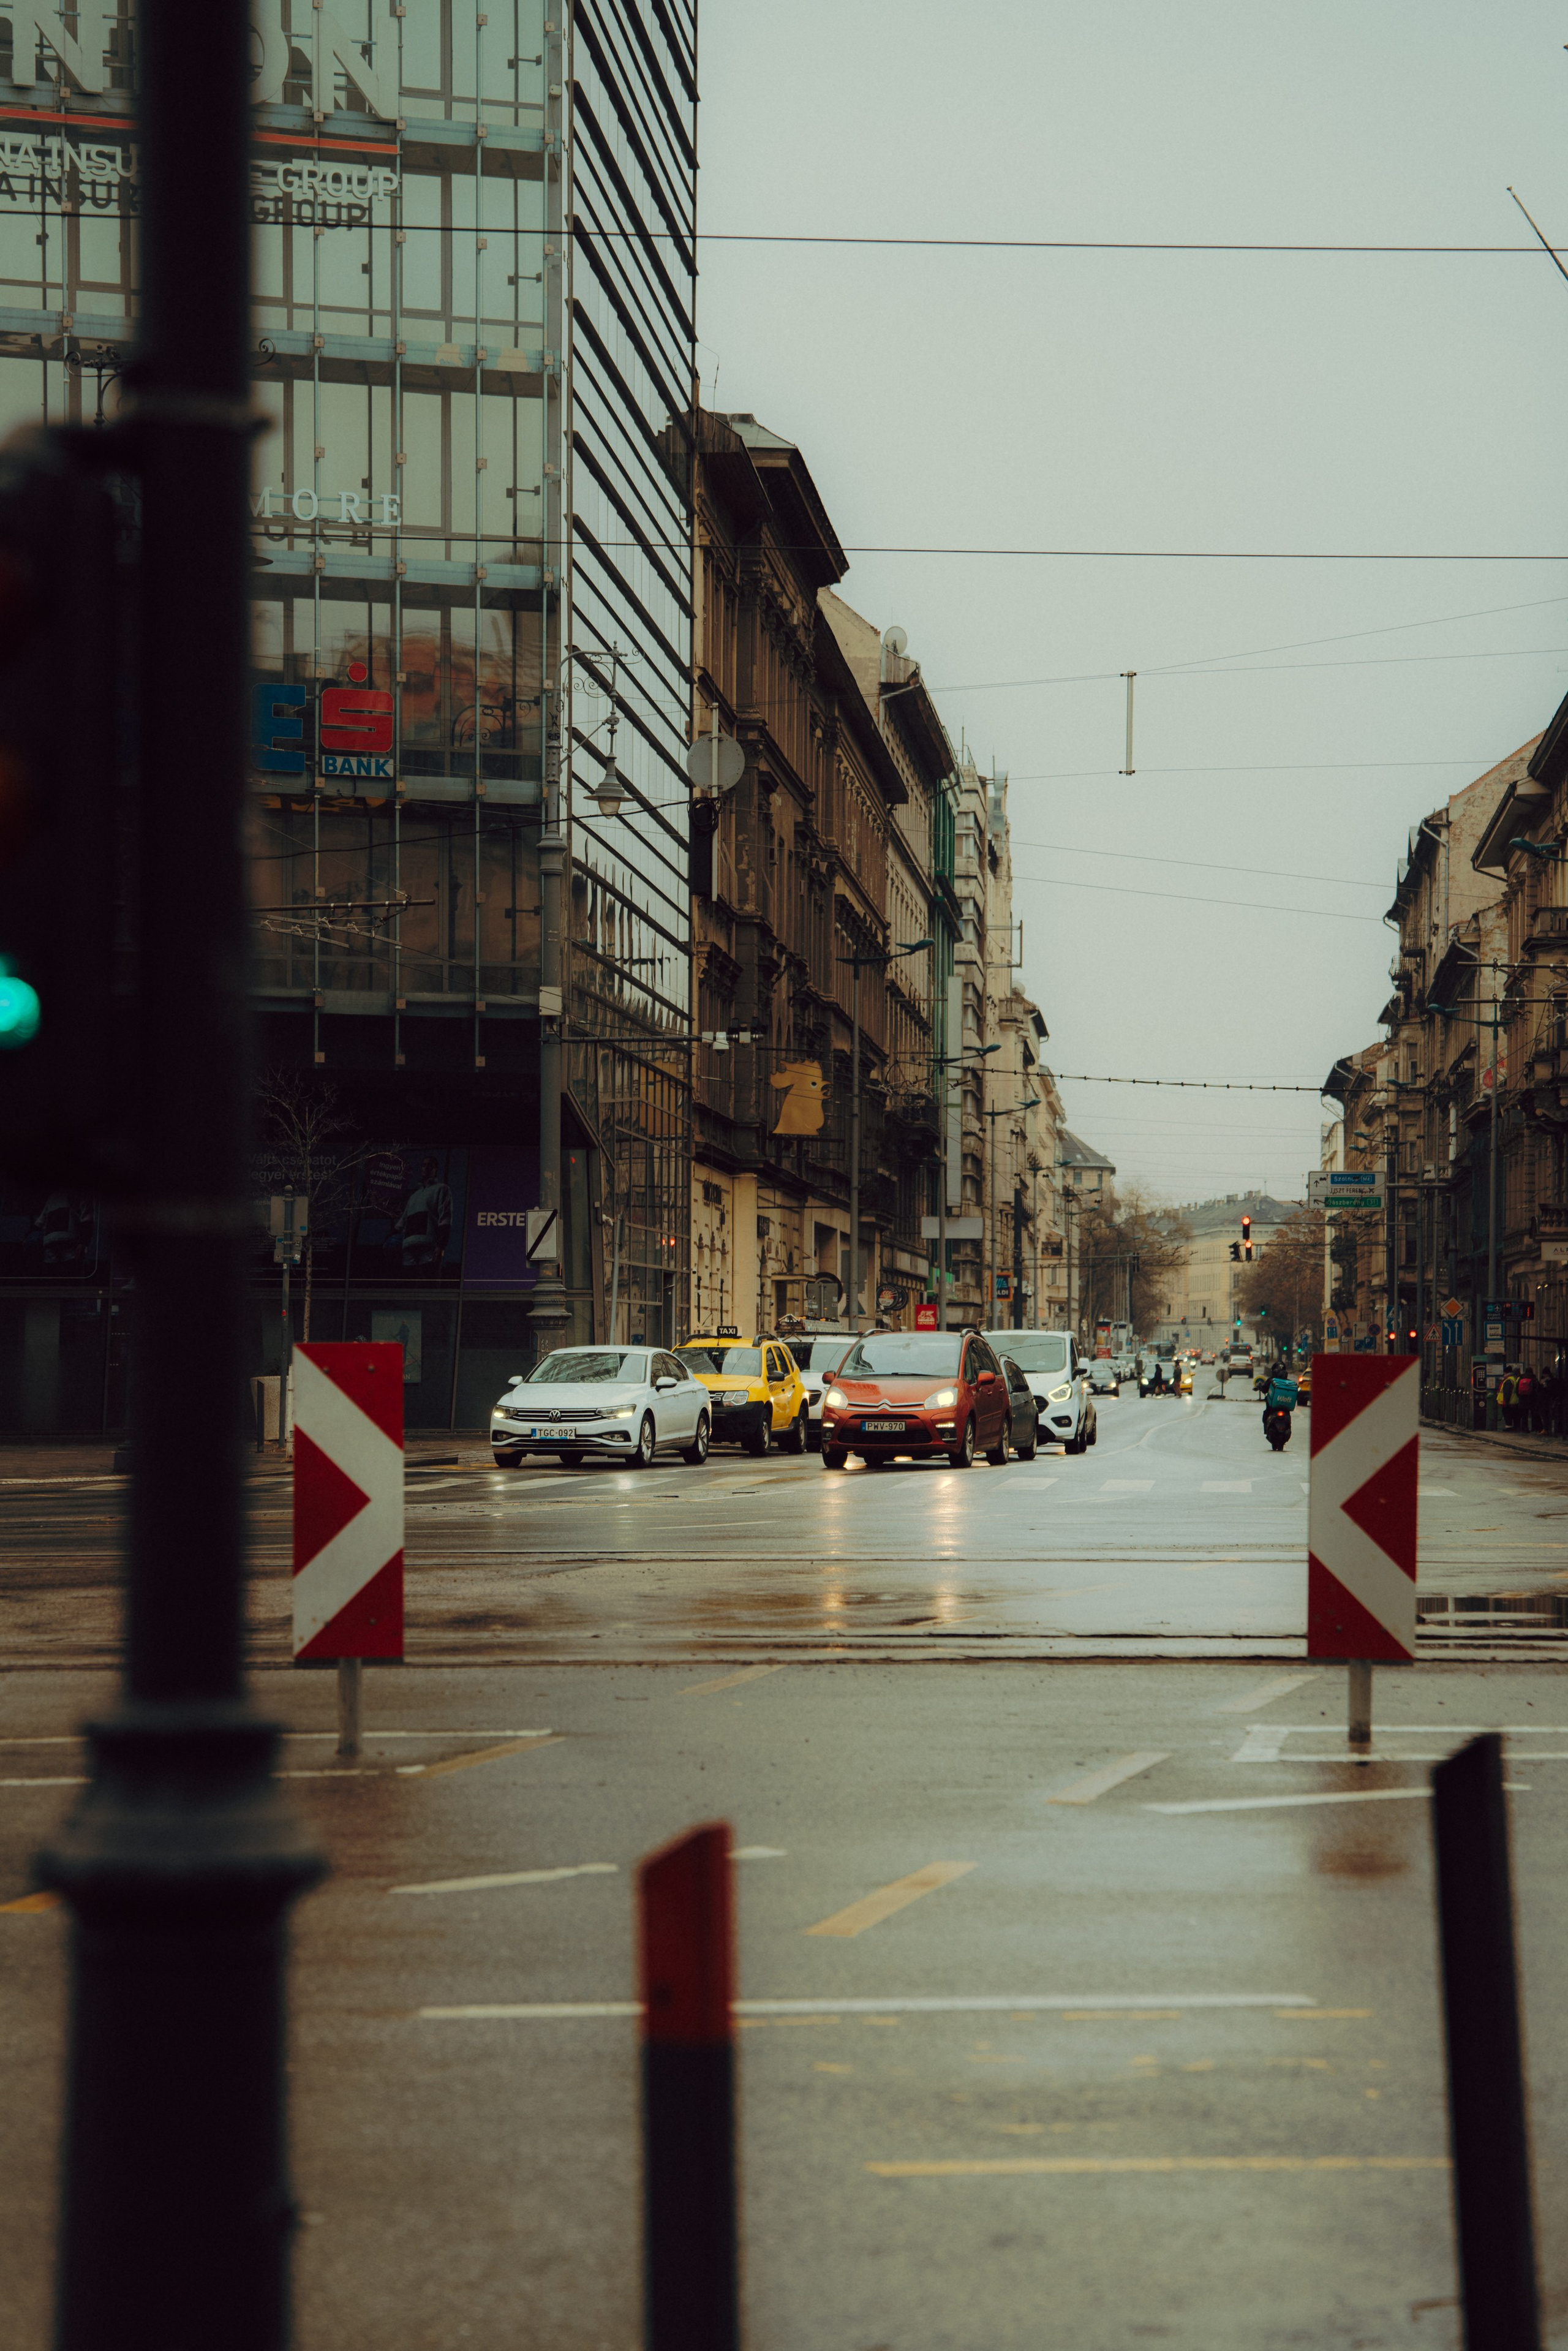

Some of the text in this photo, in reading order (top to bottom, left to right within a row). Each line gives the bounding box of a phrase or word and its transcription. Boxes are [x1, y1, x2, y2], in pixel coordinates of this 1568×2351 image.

[277, 163, 398, 201] GROUP
[324, 757, 391, 777] BANK
[379, 1161, 401, 1171] Ingyen
[477, 1212, 526, 1227] ERSTE
